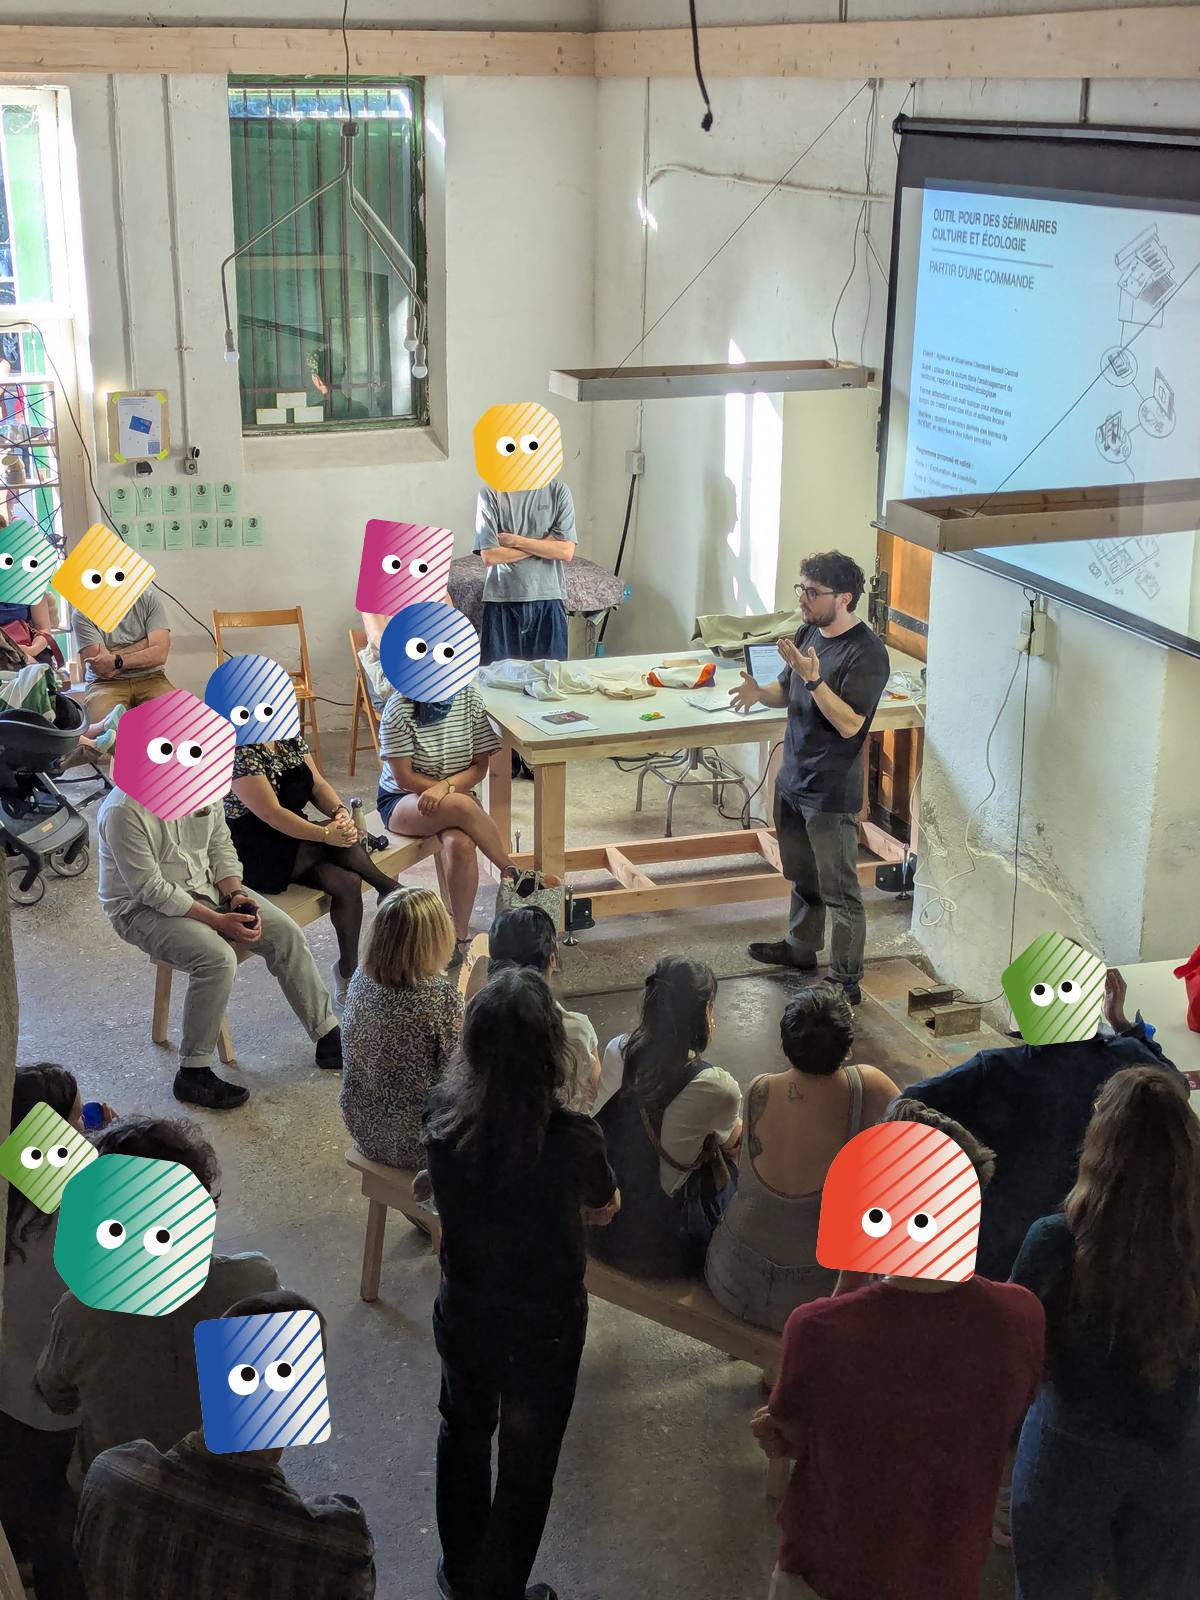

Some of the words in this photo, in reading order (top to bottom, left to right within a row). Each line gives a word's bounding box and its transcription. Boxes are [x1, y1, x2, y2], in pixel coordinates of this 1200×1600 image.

[933, 208, 956, 223] OUTIL
[958, 210, 982, 226] POUR
[983, 213, 1001, 228] DES
[1001, 212, 1058, 235] SÉMINAIRES
[932, 227, 968, 244] CULTURE
[969, 231, 981, 246] ET
[981, 229, 1027, 252] ÉCOLOGIE
[929, 260, 957, 277] PARTIR
[958, 264, 983, 282] D'UNE
[983, 269, 1035, 290] COMMANDE
